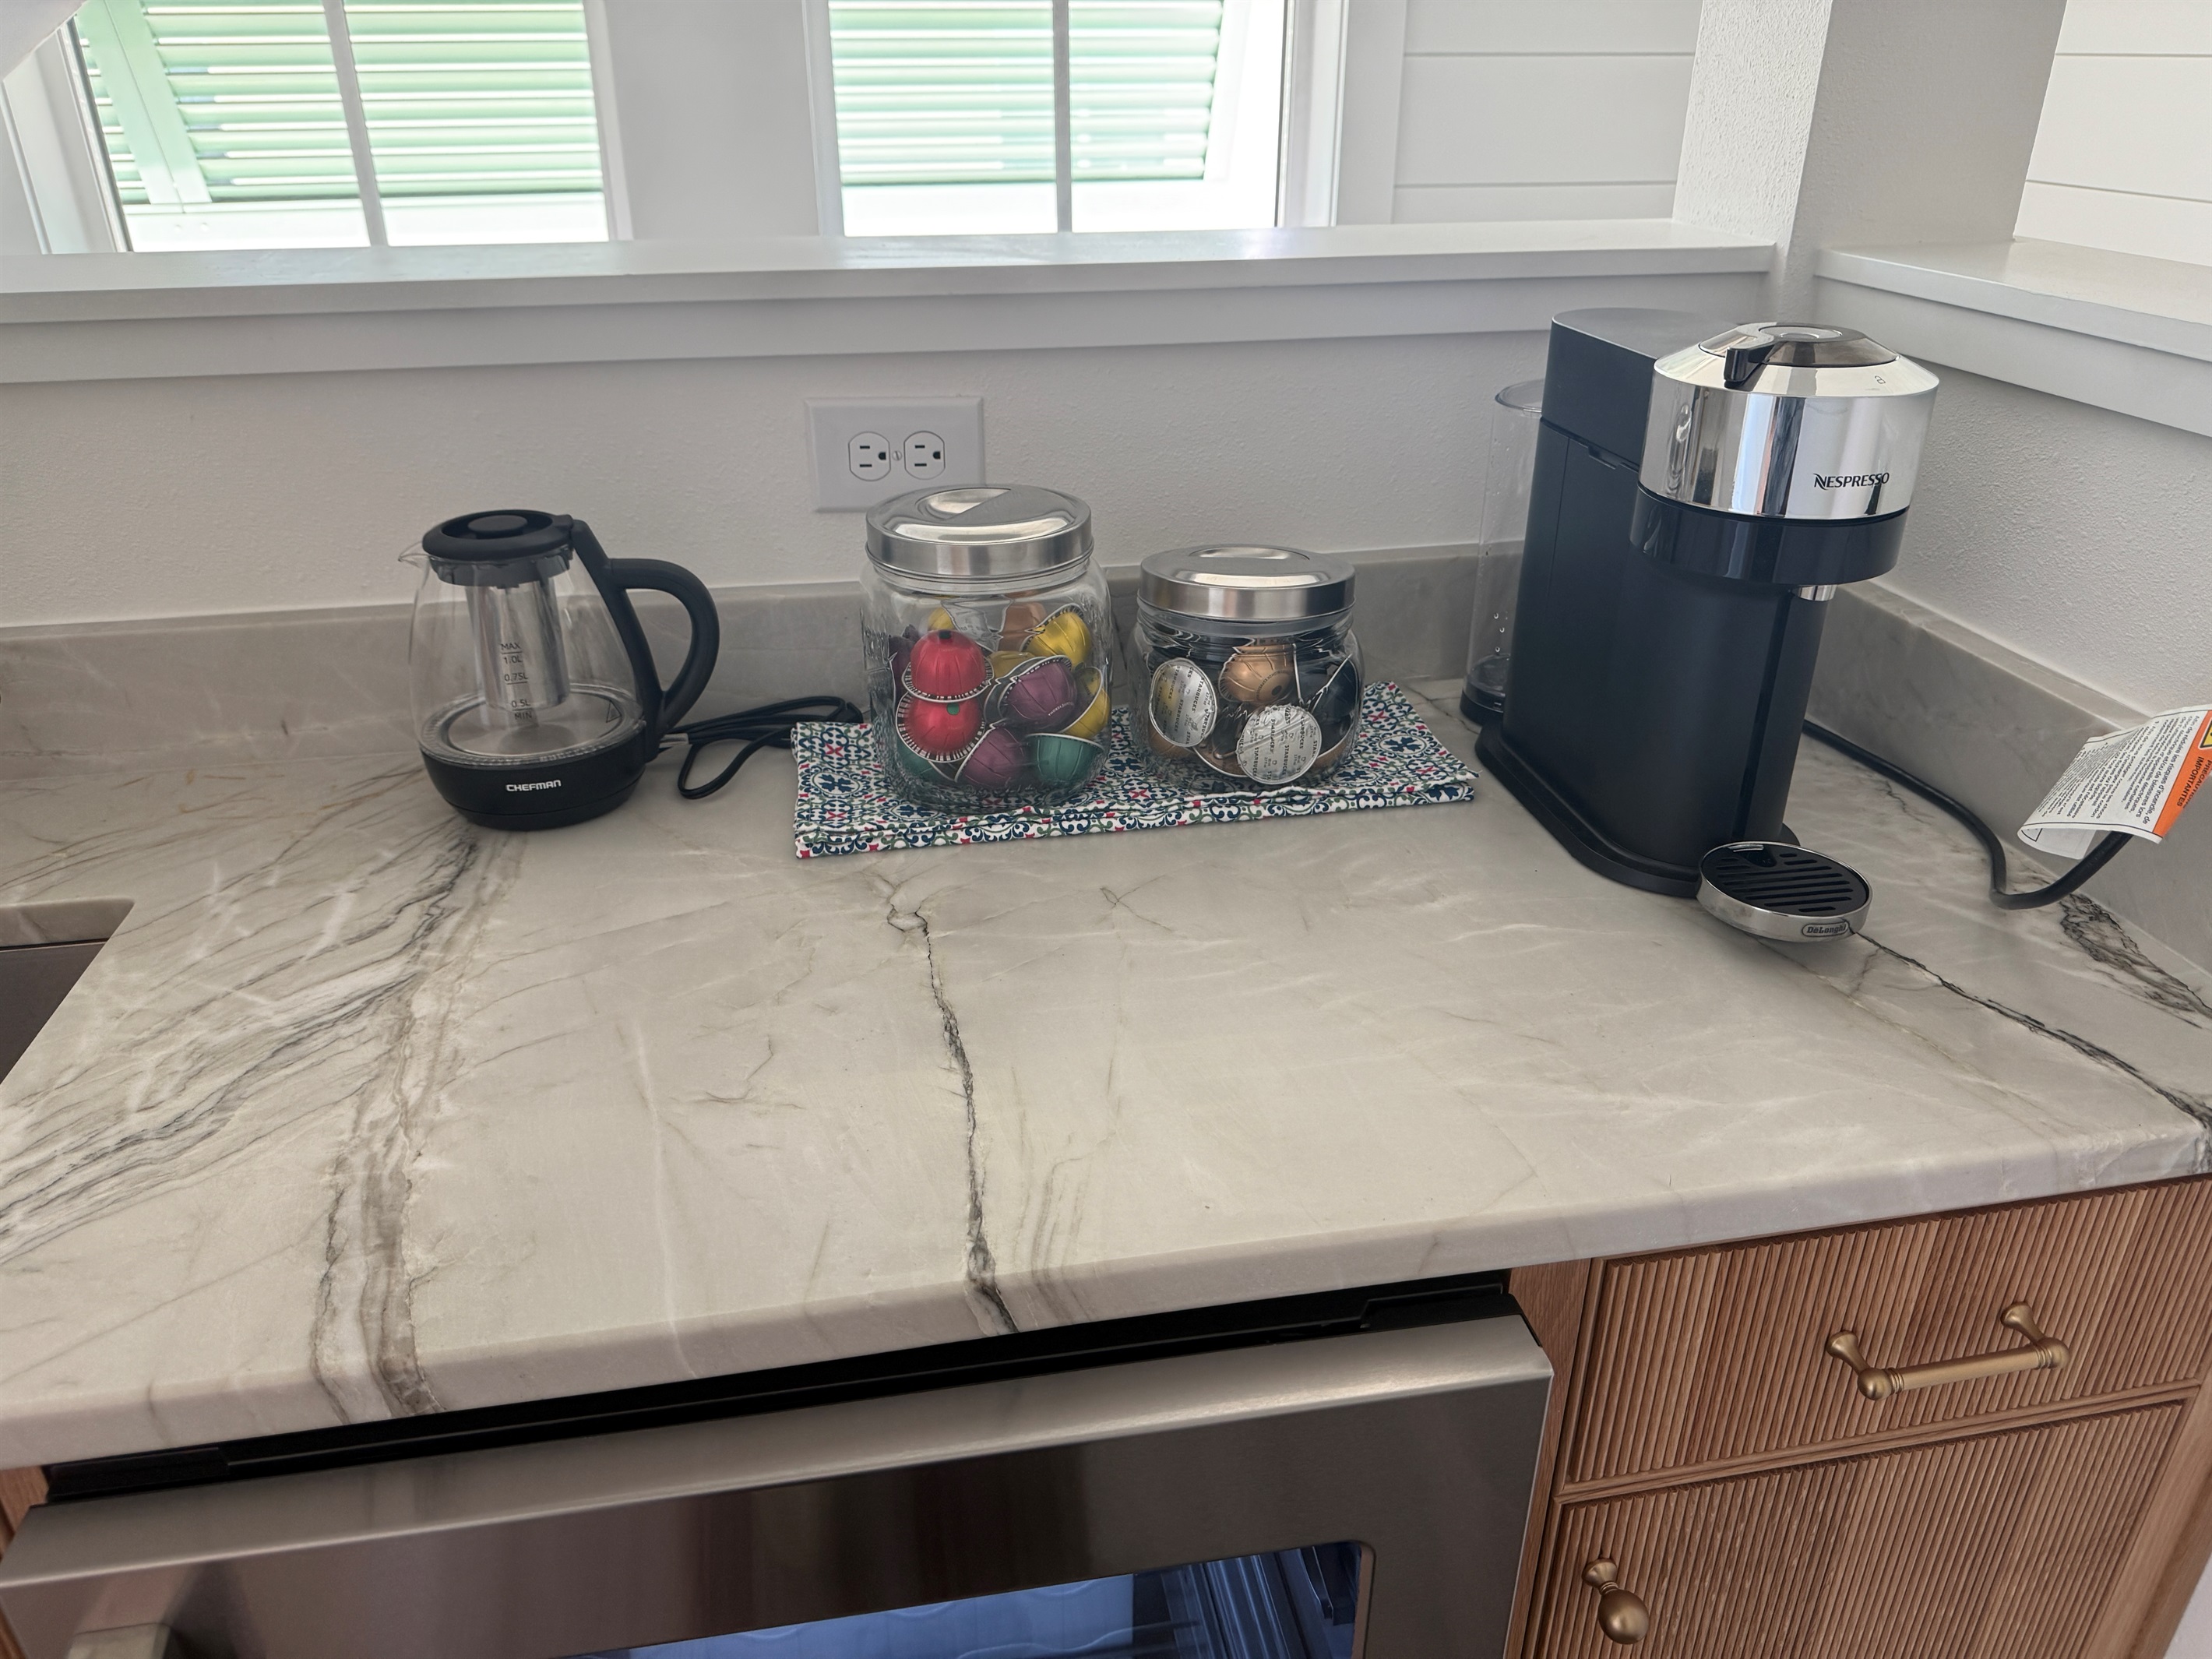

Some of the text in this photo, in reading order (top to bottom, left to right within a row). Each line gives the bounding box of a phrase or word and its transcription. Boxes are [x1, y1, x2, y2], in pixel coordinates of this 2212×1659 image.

[1812, 472, 1890, 491] NESPRESSO
[504, 672, 529, 682] 0.75L
[505, 780, 562, 791] CHEFMAN
[2177, 756, 2204, 807] IMPORTANTES
